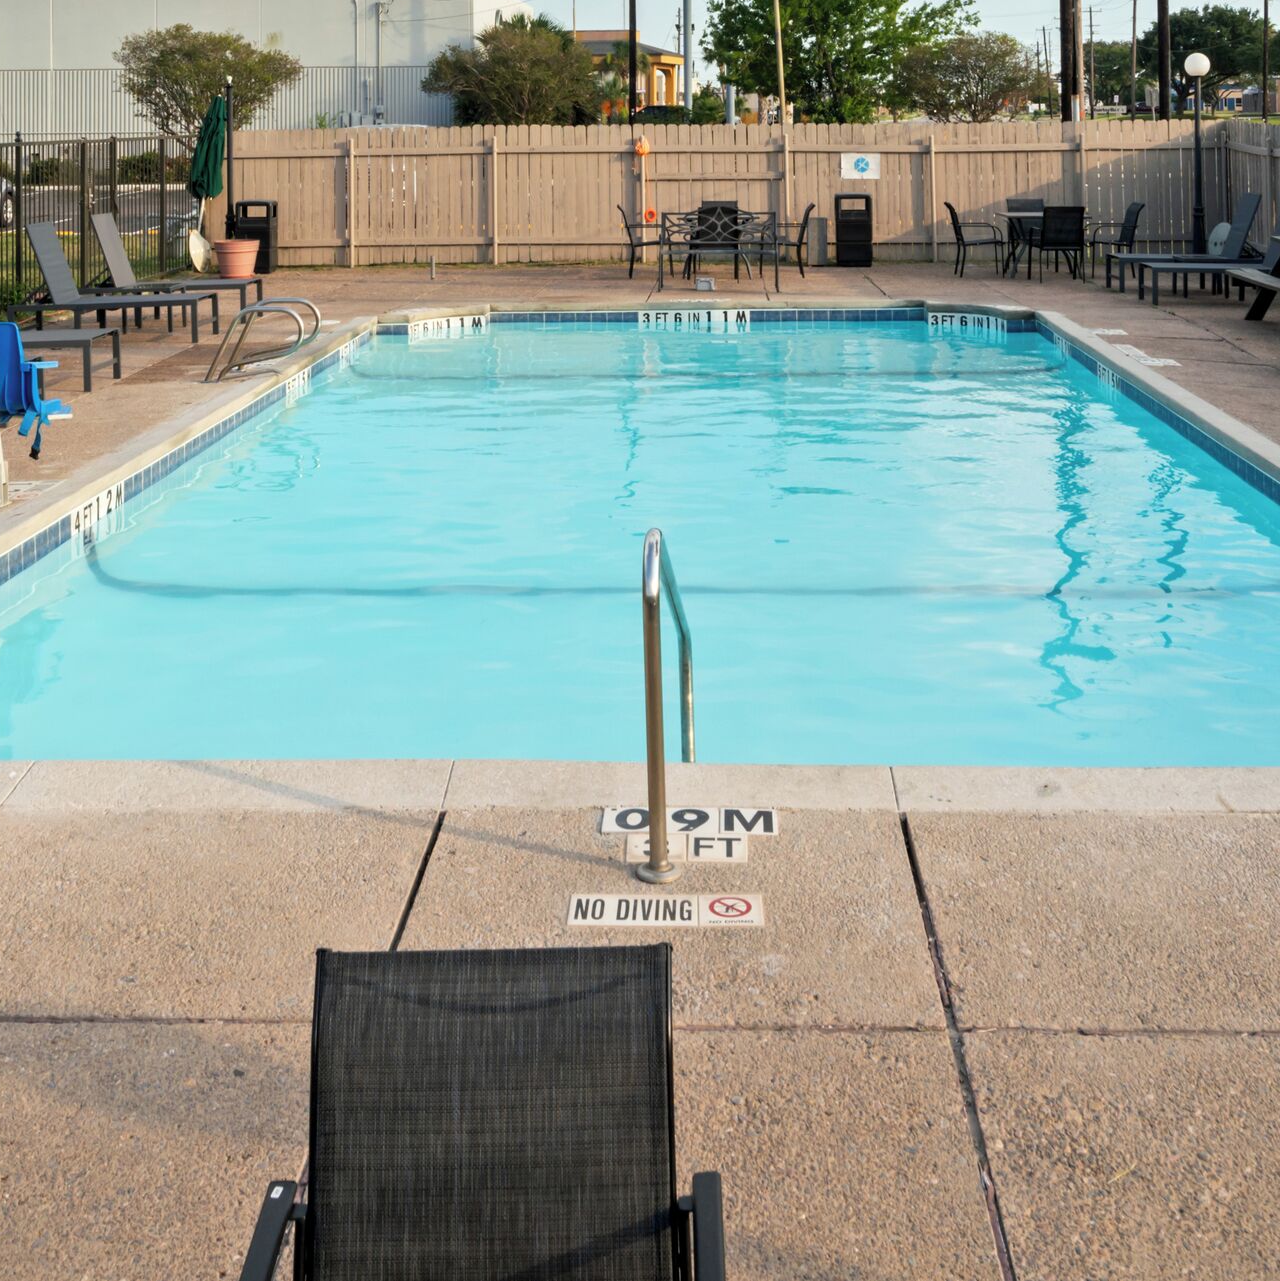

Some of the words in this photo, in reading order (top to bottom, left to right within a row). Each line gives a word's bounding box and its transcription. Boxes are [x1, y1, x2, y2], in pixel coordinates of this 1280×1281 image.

[643, 312, 650, 323] 3
[656, 312, 668, 323] FT
[674, 312, 682, 323] 6
[688, 312, 700, 323] IN
[931, 315, 939, 326] 3
[942, 315, 955, 326] FT
[960, 315, 968, 327] 6
[973, 316, 984, 328] IN
[75, 510, 81, 532] 4
[84, 502, 93, 529] FT
[693, 837, 742, 858] FT
[574, 898, 606, 920] NO
[616, 898, 693, 921] DIVING
